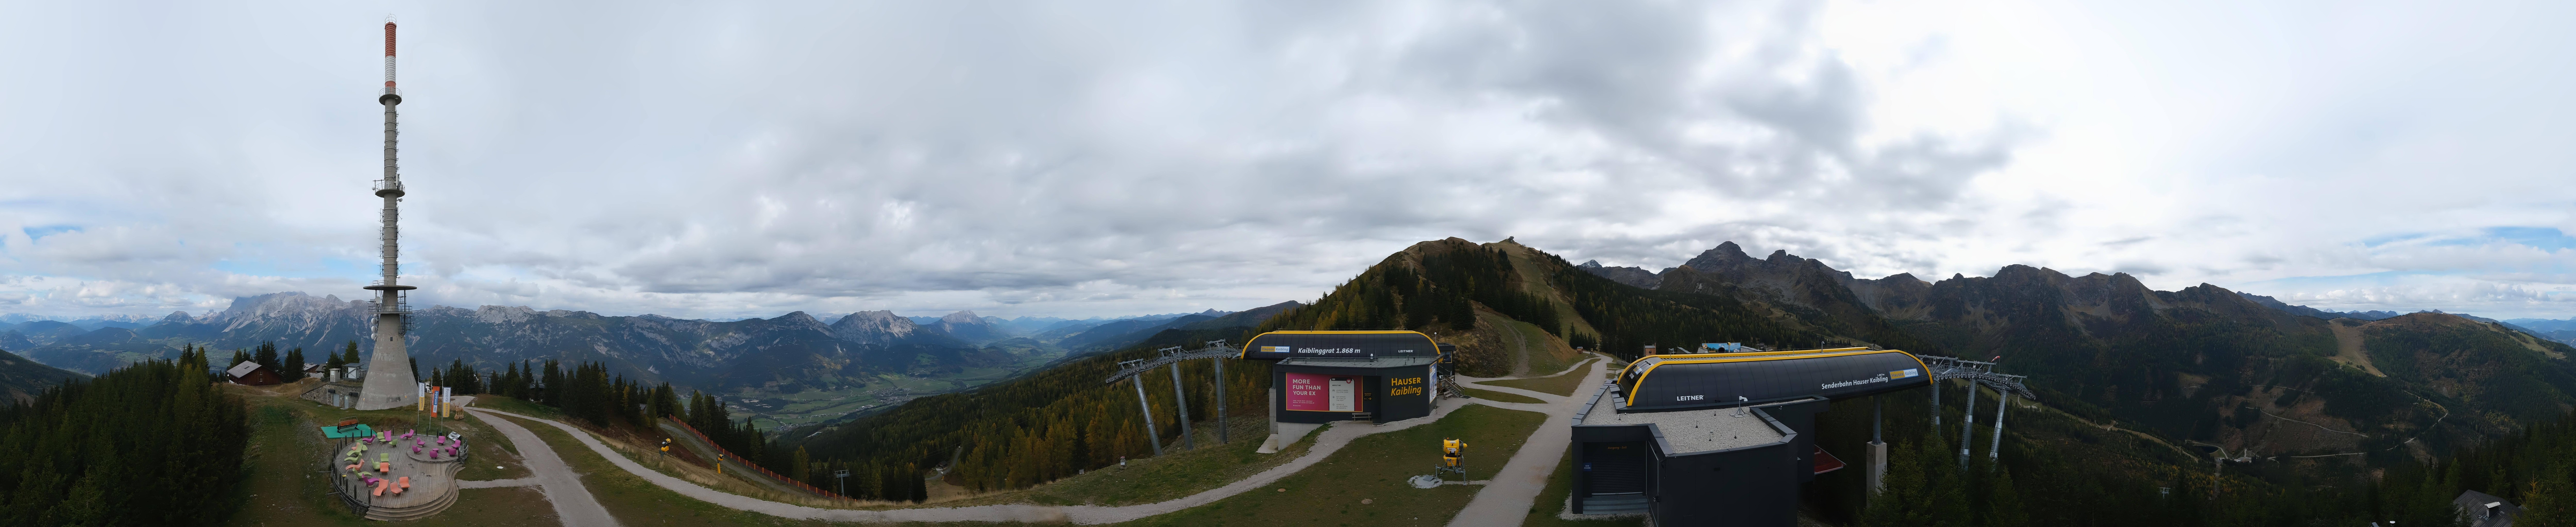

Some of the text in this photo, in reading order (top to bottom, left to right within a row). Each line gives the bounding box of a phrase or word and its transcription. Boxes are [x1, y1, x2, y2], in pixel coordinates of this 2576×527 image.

[1392, 377, 1421, 386] HAUSER
[1822, 380, 1852, 389] Senderbahn
[1391, 386, 1421, 396] Kaibling
